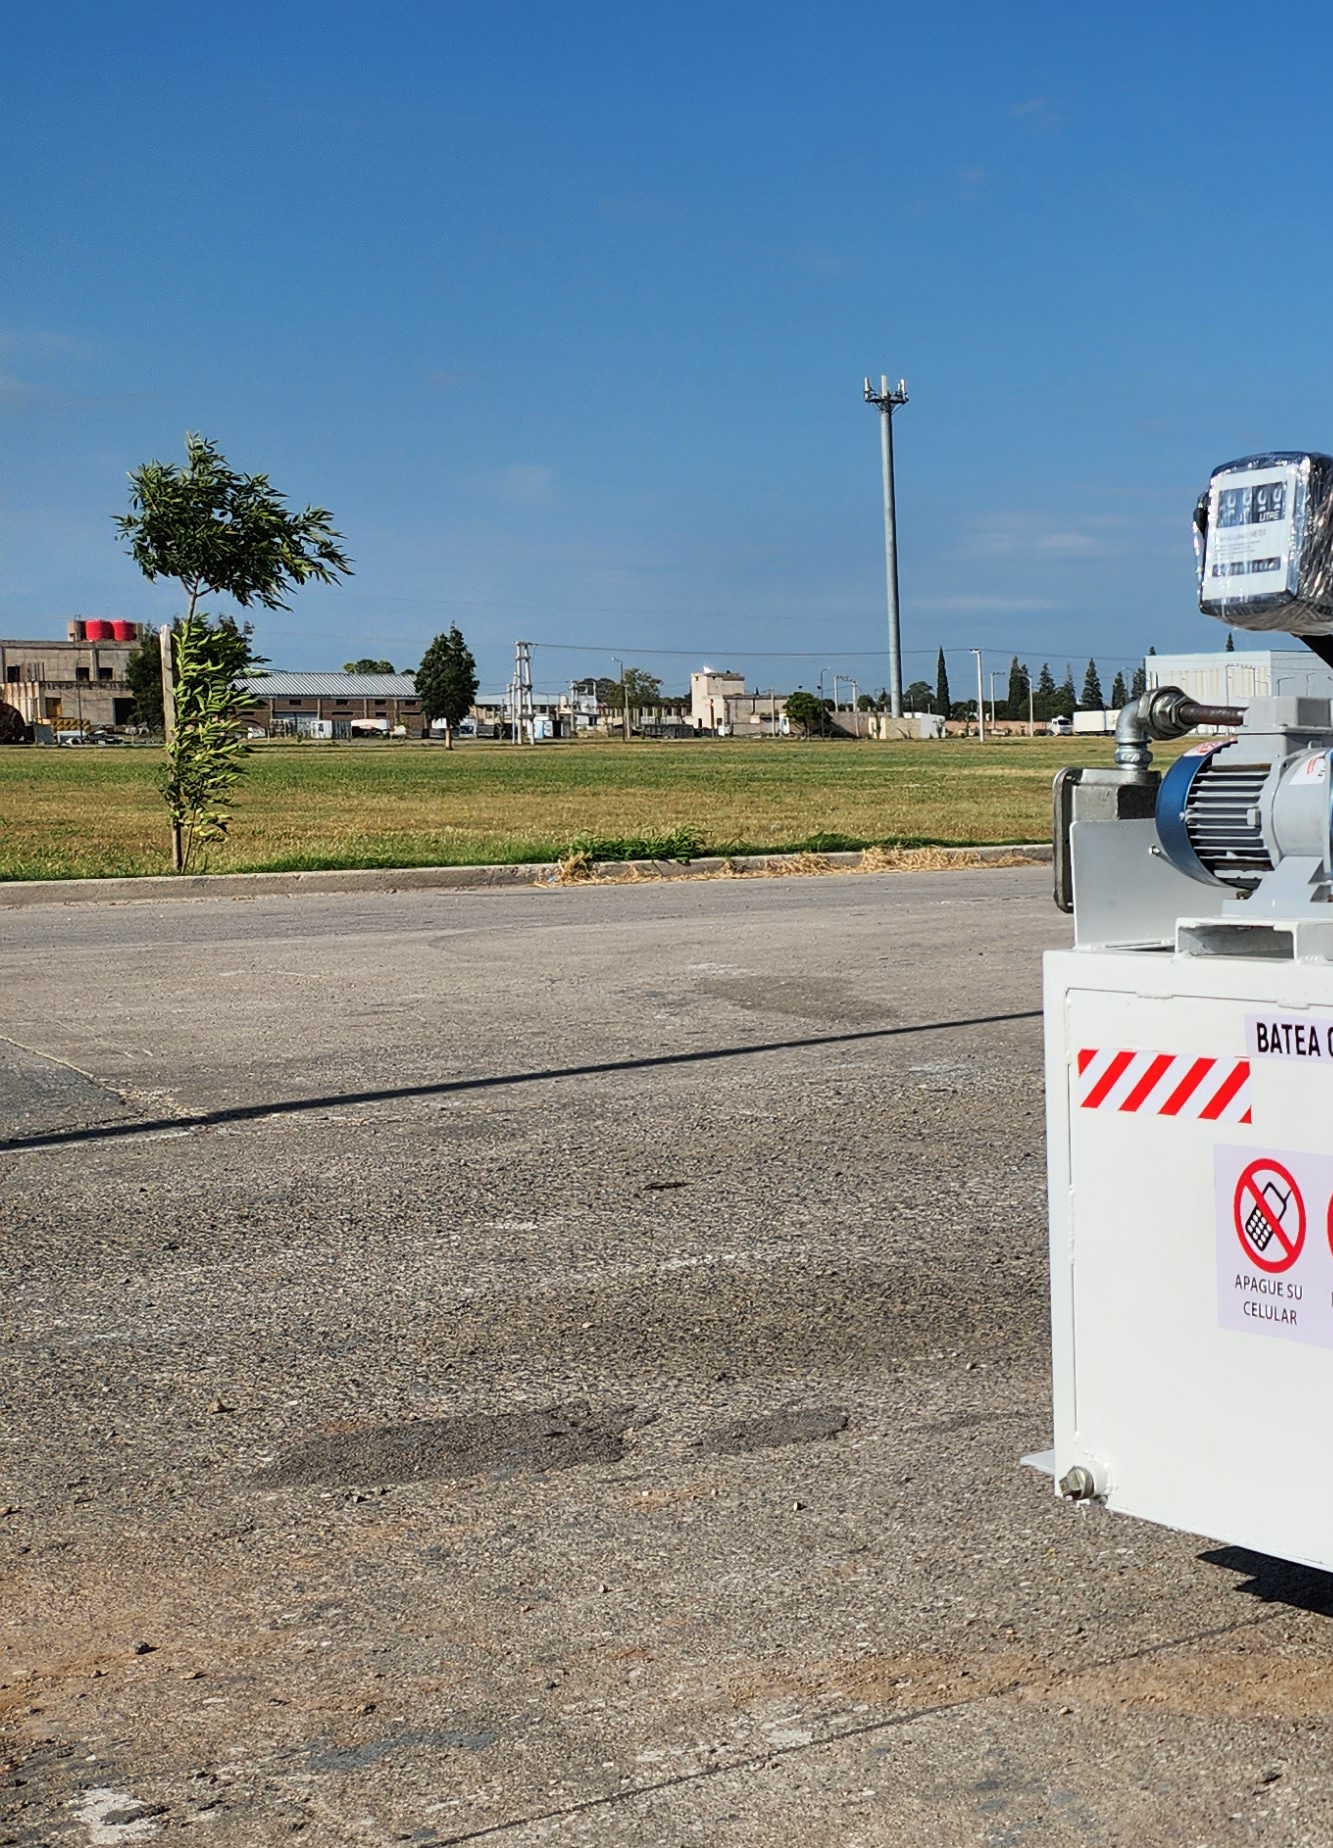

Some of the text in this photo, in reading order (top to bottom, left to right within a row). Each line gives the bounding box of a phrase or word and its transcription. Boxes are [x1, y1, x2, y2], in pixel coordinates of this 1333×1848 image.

[1256, 1022, 1321, 1057] BATEA
[1234, 1274, 1303, 1300] APAGUE SU
[1243, 1301, 1297, 1325] CELULAR
